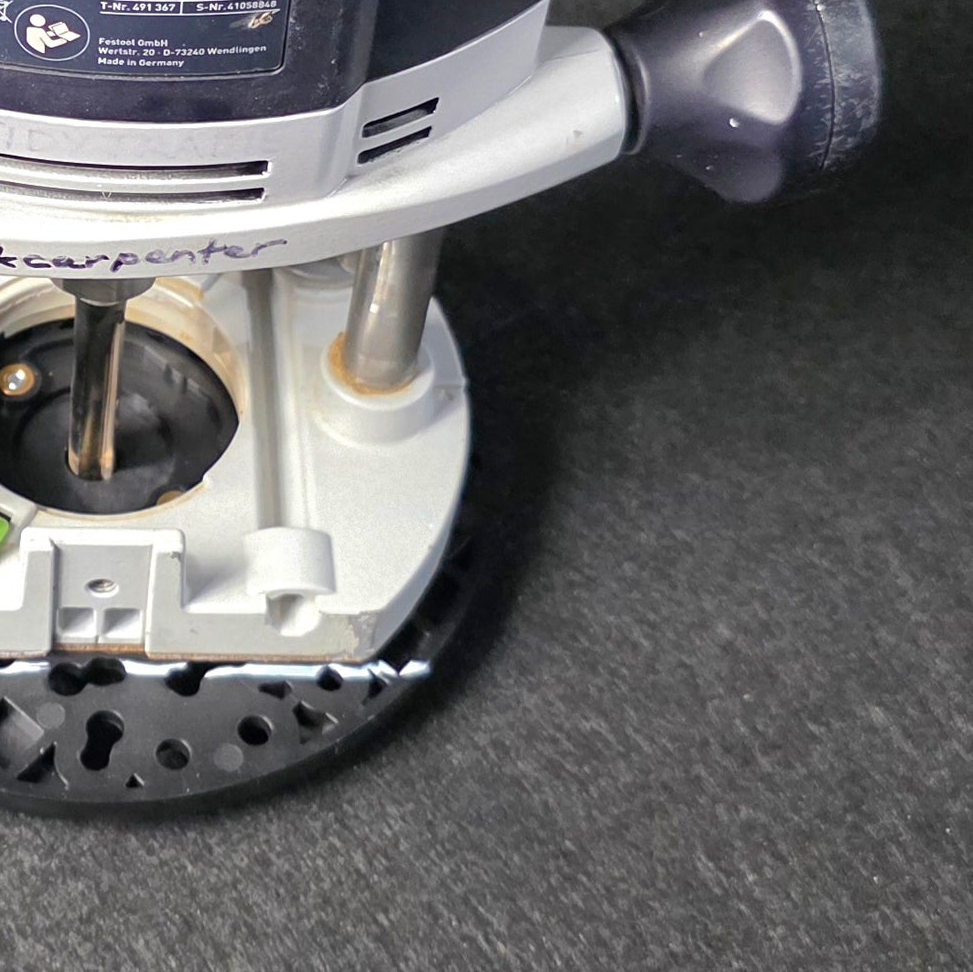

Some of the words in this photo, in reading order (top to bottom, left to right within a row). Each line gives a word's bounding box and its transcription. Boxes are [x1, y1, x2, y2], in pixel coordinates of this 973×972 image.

[132, 3, 152, 12] 491
[154, 4, 176, 12] 367
[98, 37, 136, 46] Festool
[137, 38, 168, 47] GmbH
[142, 48, 156, 57] 20
[163, 47, 205, 57] D-73240
[207, 44, 267, 56] Wendlingen
[97, 57, 125, 66] Made
[127, 58, 137, 67] in
[138, 59, 185, 69] Germany
